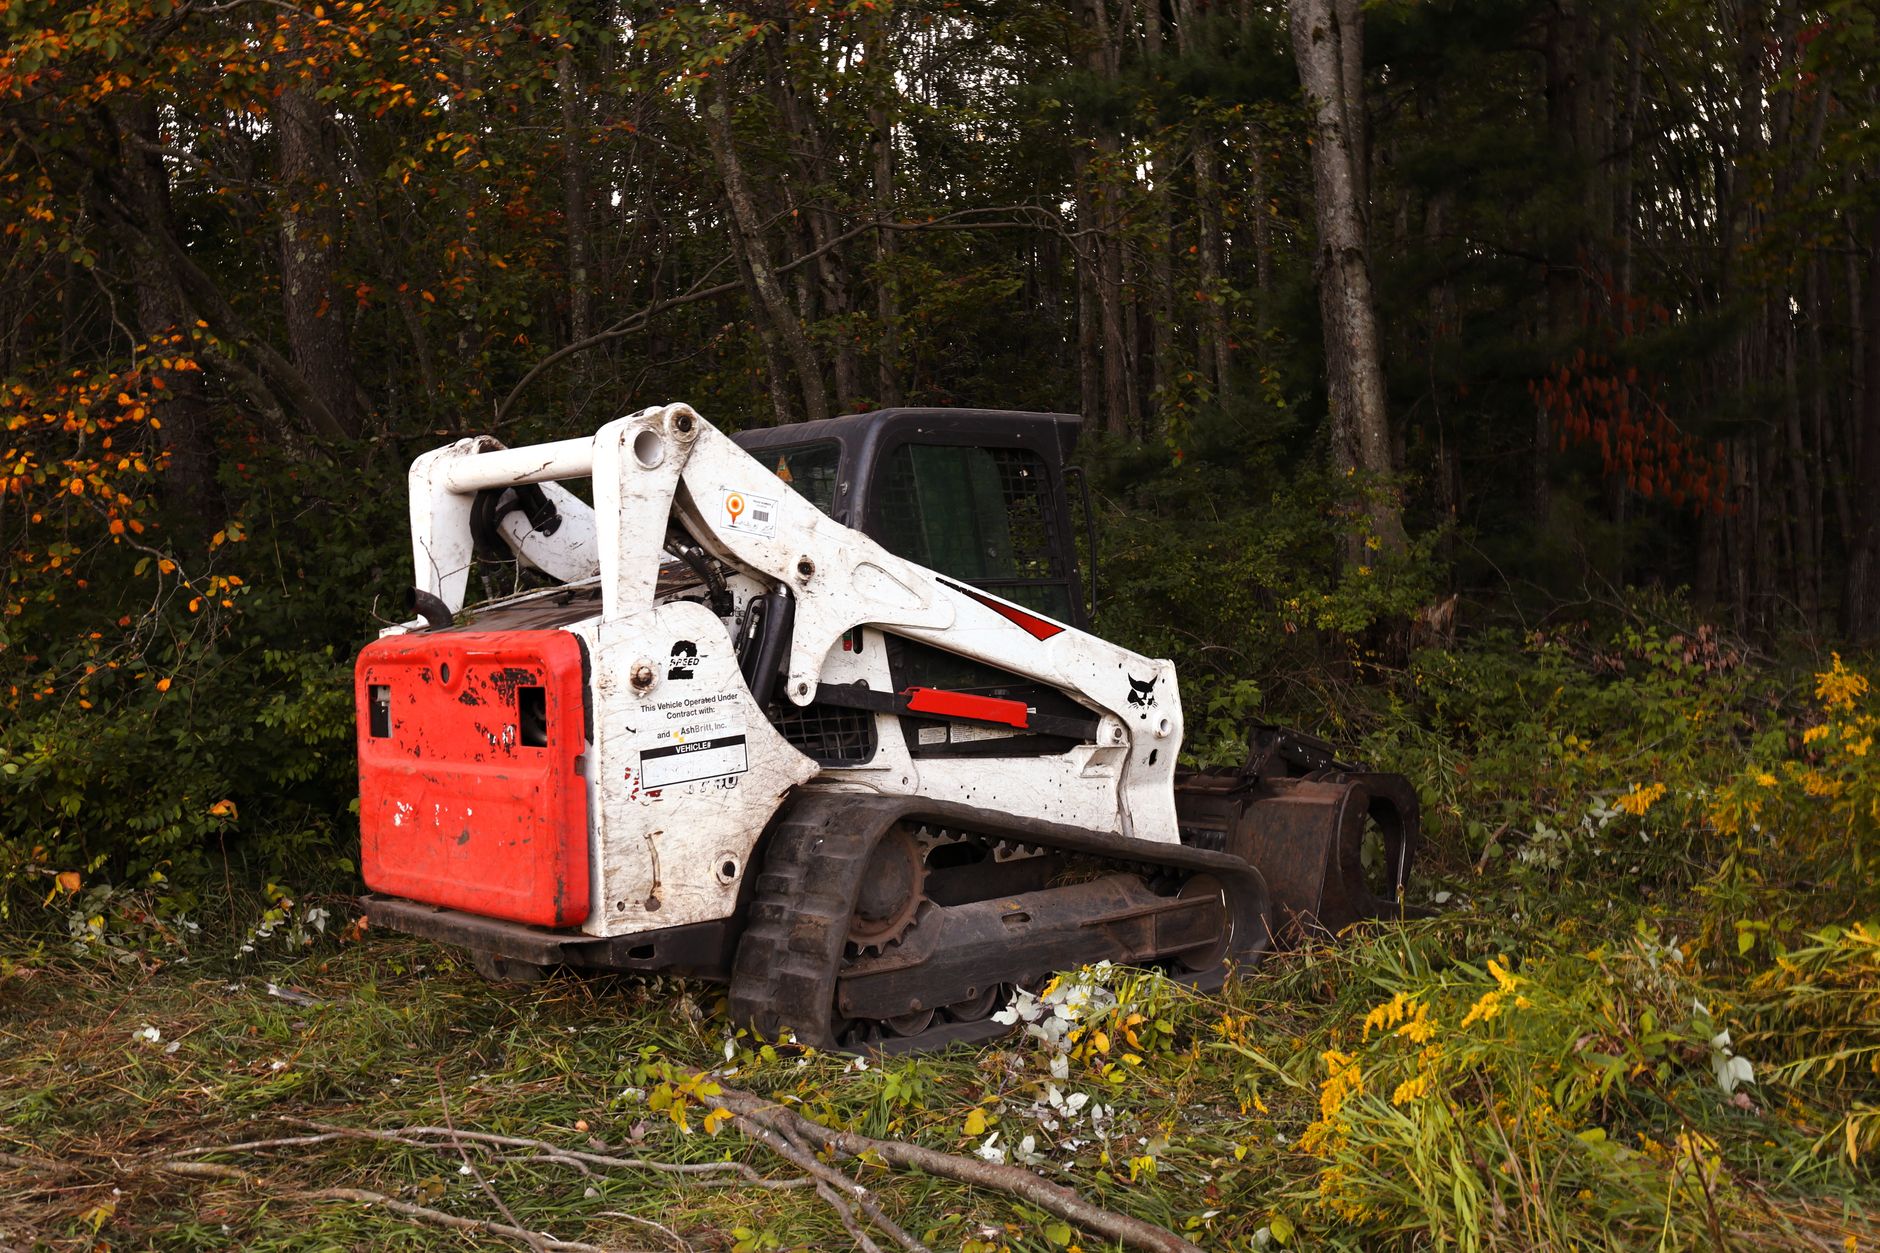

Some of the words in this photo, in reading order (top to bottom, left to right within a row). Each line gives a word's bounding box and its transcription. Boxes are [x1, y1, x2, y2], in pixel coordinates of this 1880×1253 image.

[668, 640, 698, 680] 2
[641, 705, 656, 713] This
[657, 701, 682, 710] Vehicle
[684, 696, 716, 708] Operated
[717, 692, 738, 702] Under
[666, 710, 698, 720] Contract
[698, 707, 716, 716] with:
[657, 731, 671, 739] and
[680, 722, 714, 735] AshBritt,
[715, 722, 727, 730] Inc.
